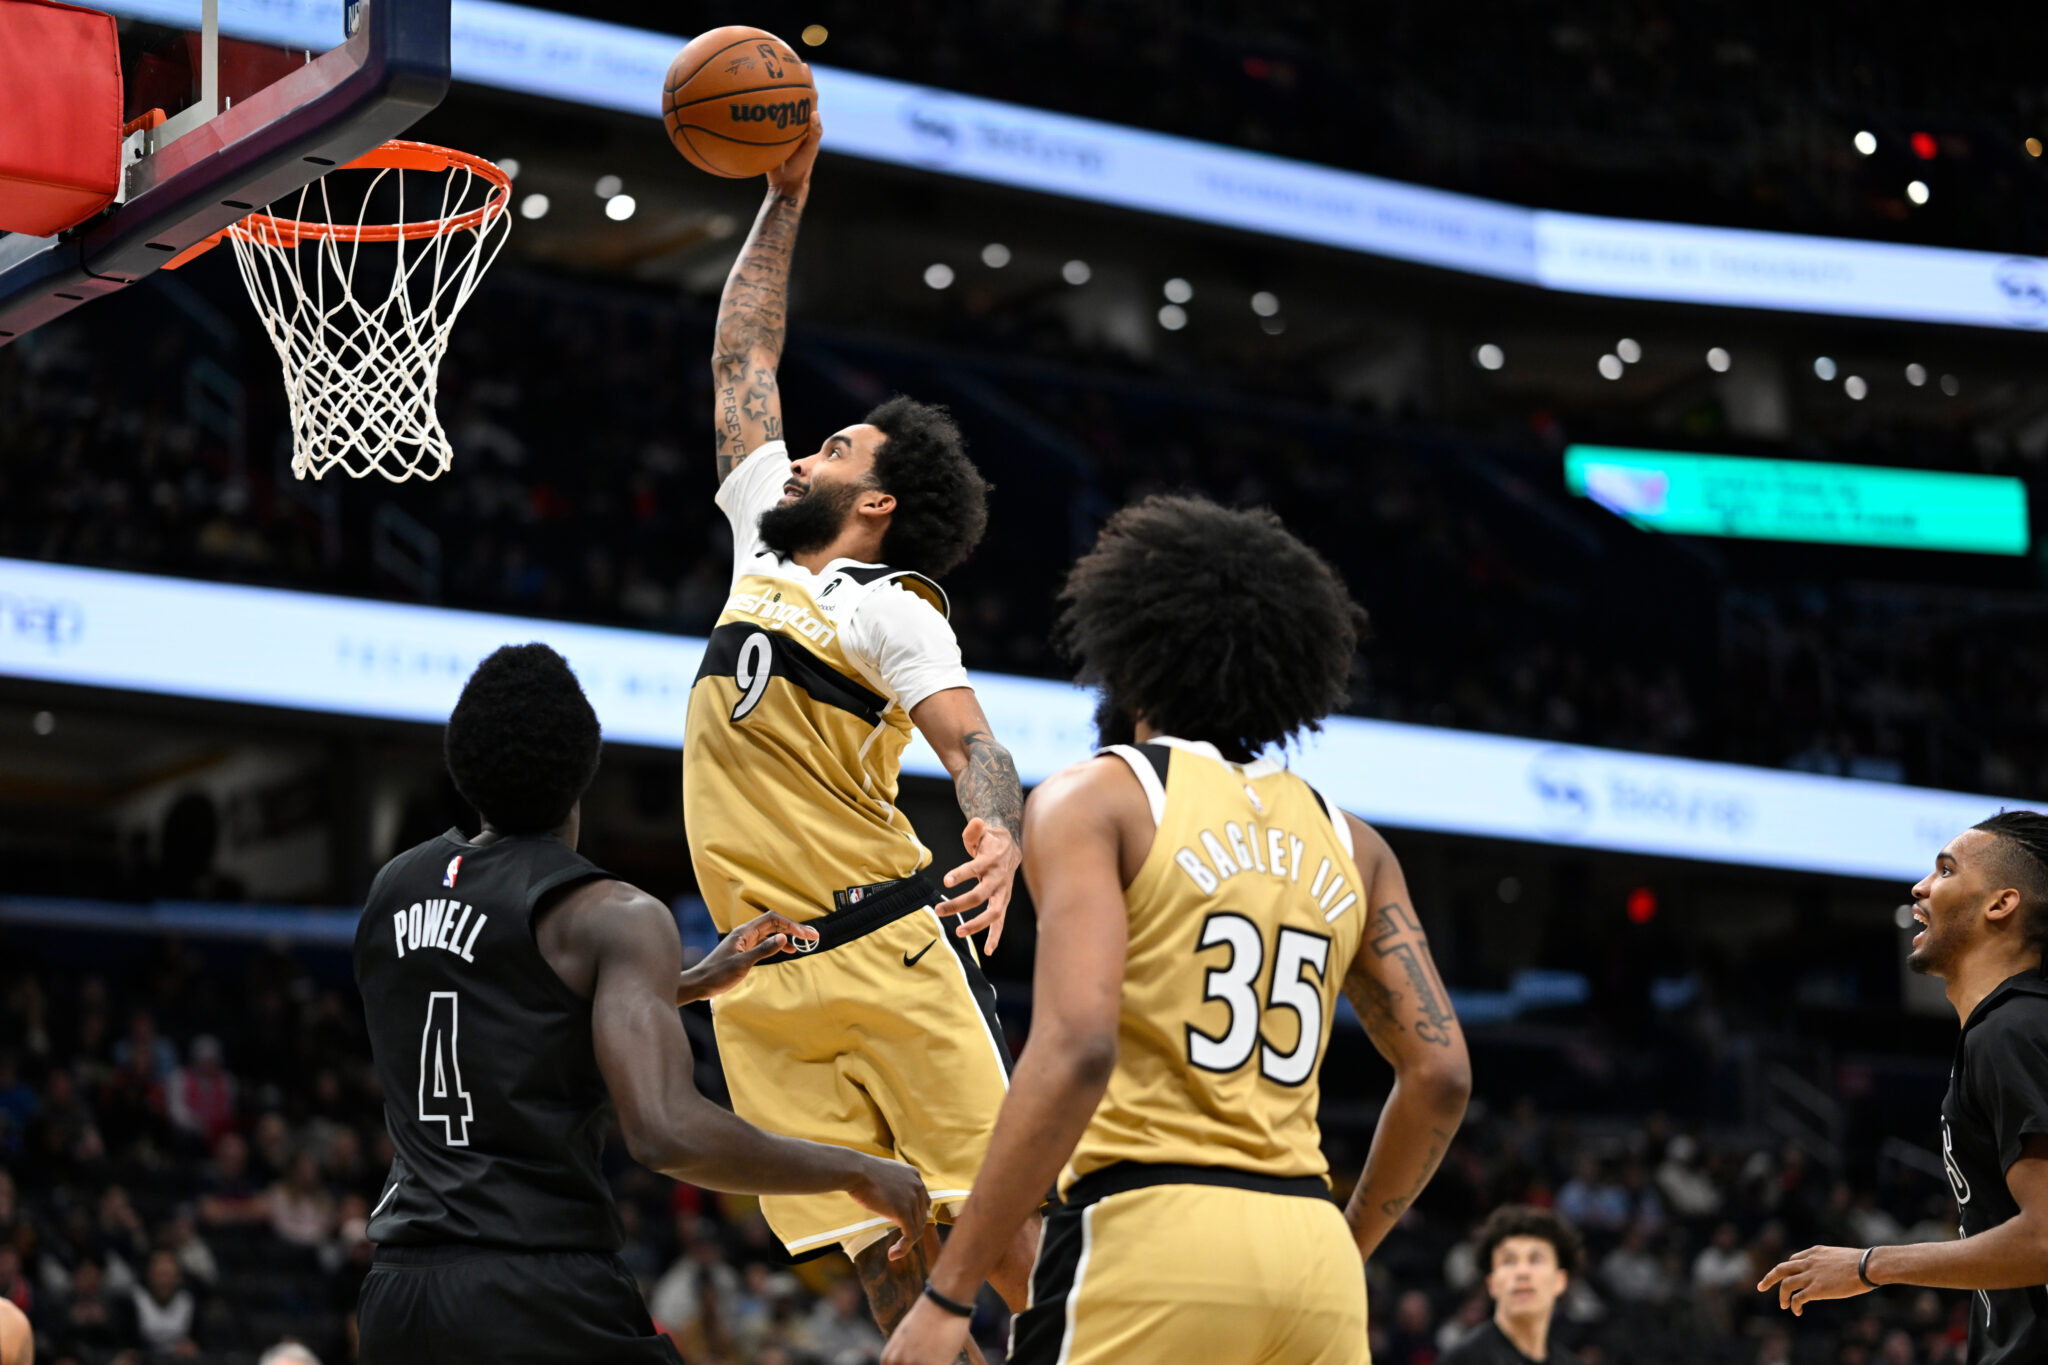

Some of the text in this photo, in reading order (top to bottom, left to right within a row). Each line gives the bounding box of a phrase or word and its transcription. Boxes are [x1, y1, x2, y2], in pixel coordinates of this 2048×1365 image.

[729, 97, 811, 131] Wilson
[728, 587, 836, 649] ashington
[729, 630, 773, 722] 9
[1175, 820, 1358, 924] BAGLEY III
[393, 898, 488, 964] POWELL
[1184, 910, 1332, 1088] 35
[418, 991, 474, 1146] 4
